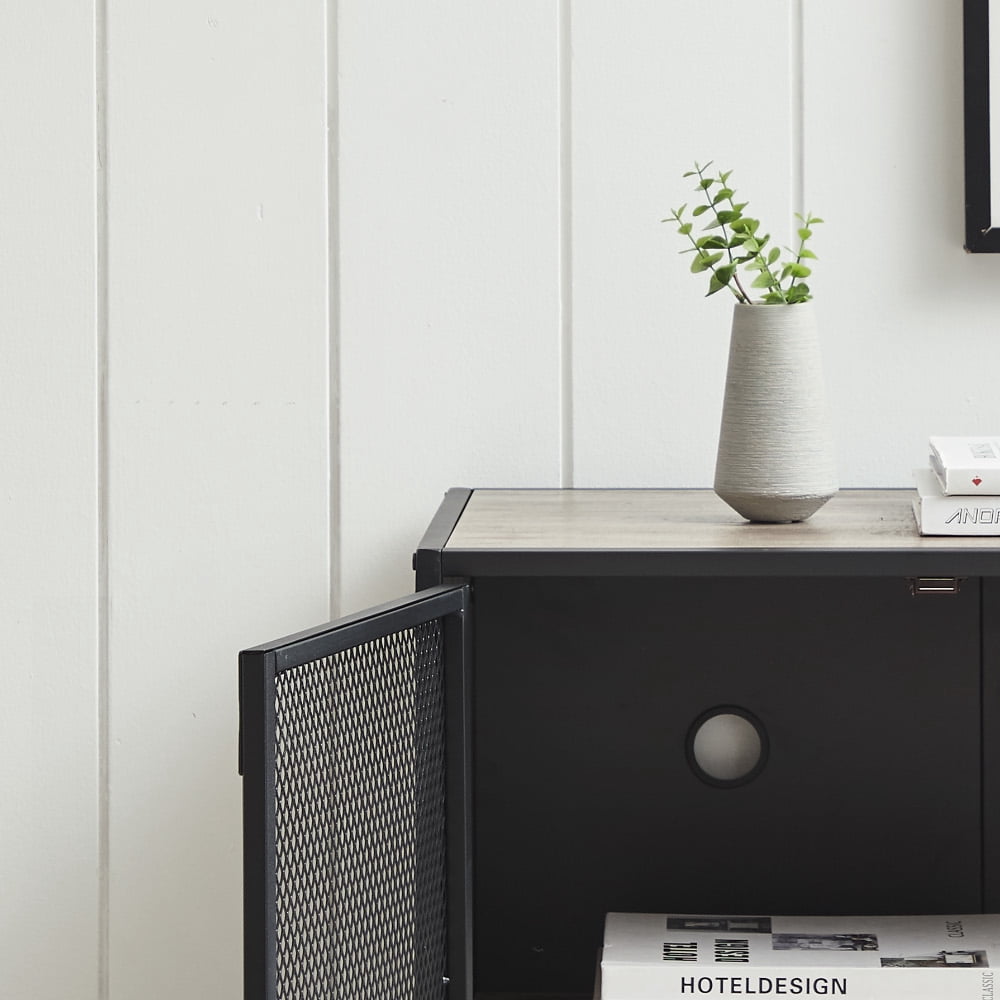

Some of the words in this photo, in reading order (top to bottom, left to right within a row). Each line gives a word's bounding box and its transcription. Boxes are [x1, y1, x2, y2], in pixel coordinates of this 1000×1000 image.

[663, 942, 698, 961] HOTEL
[714, 938, 749, 962] DESIGN
[681, 976, 847, 995] HOTELDESIGN
